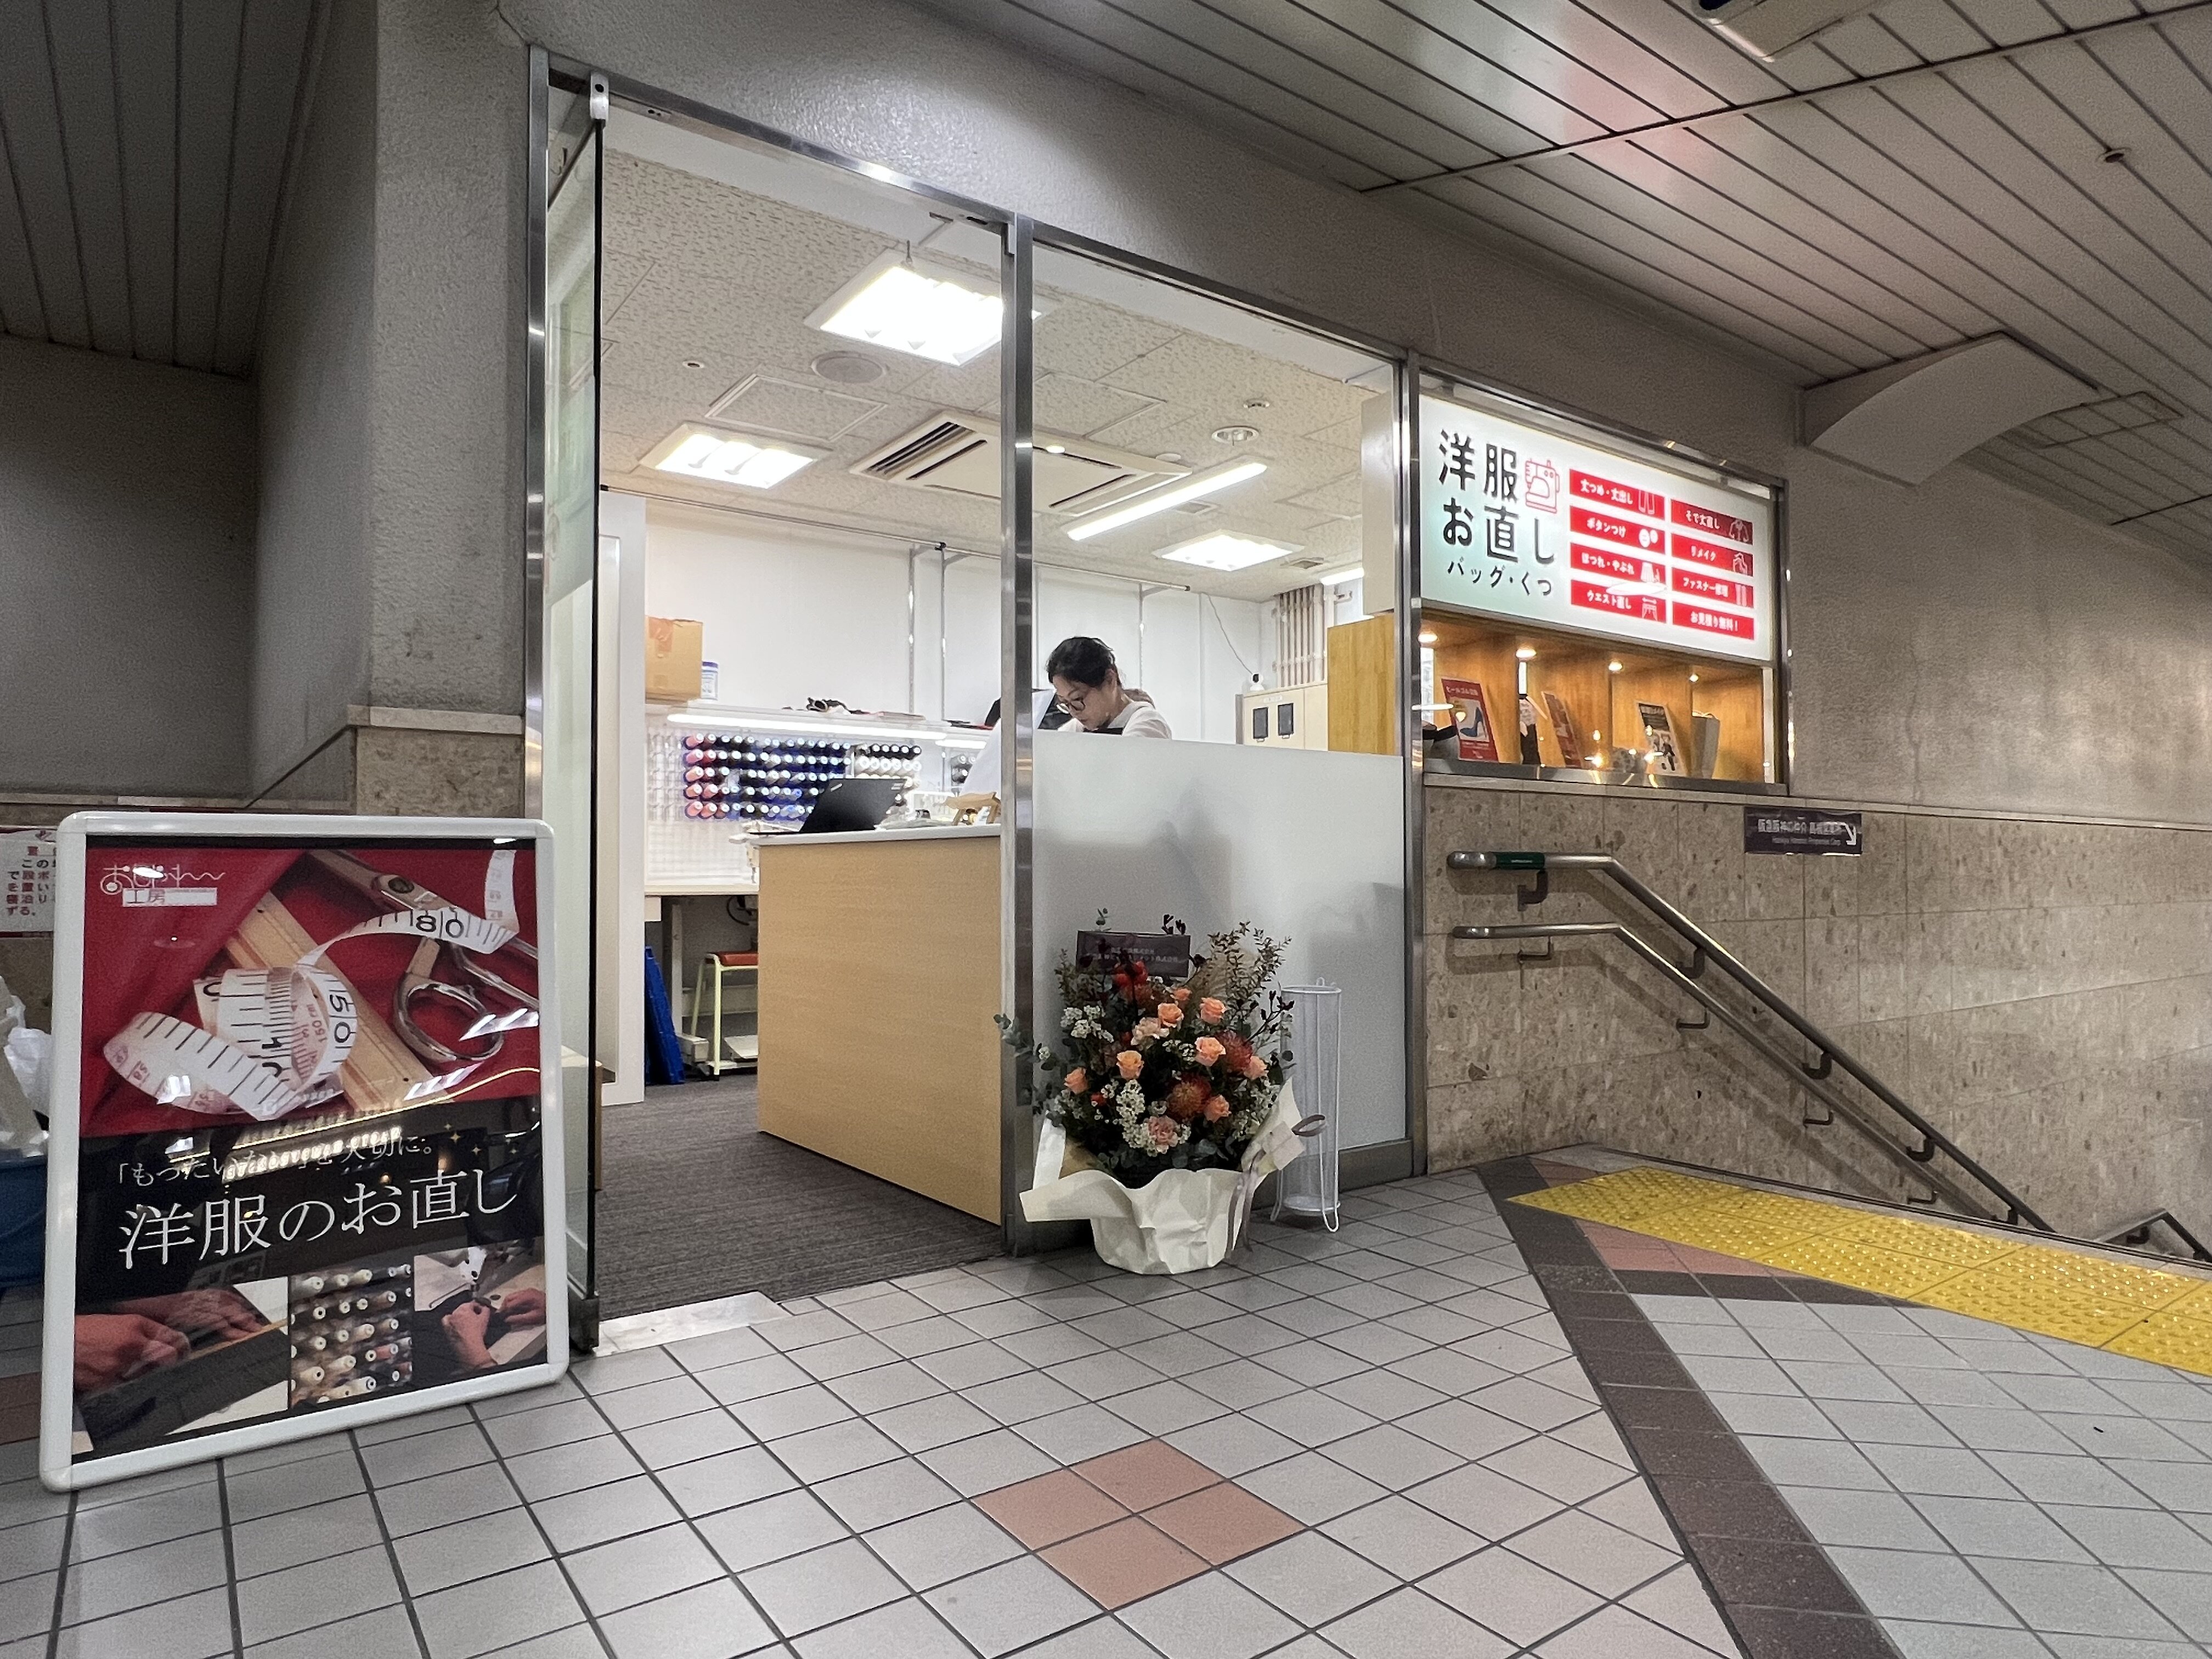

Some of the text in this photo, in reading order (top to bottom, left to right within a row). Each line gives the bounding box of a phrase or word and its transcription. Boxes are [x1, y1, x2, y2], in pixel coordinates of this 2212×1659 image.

[1438, 429, 1518, 504] 洋服
[1443, 497, 1555, 565] お直し
[1587, 517, 1627, 538] ボタンつけ
[1691, 545, 1717, 562] リメイク
[1447, 556, 1552, 596] バッグ・くつ
[416, 915, 464, 939] 80
[119, 1169, 518, 1269] 洋服のお直し
